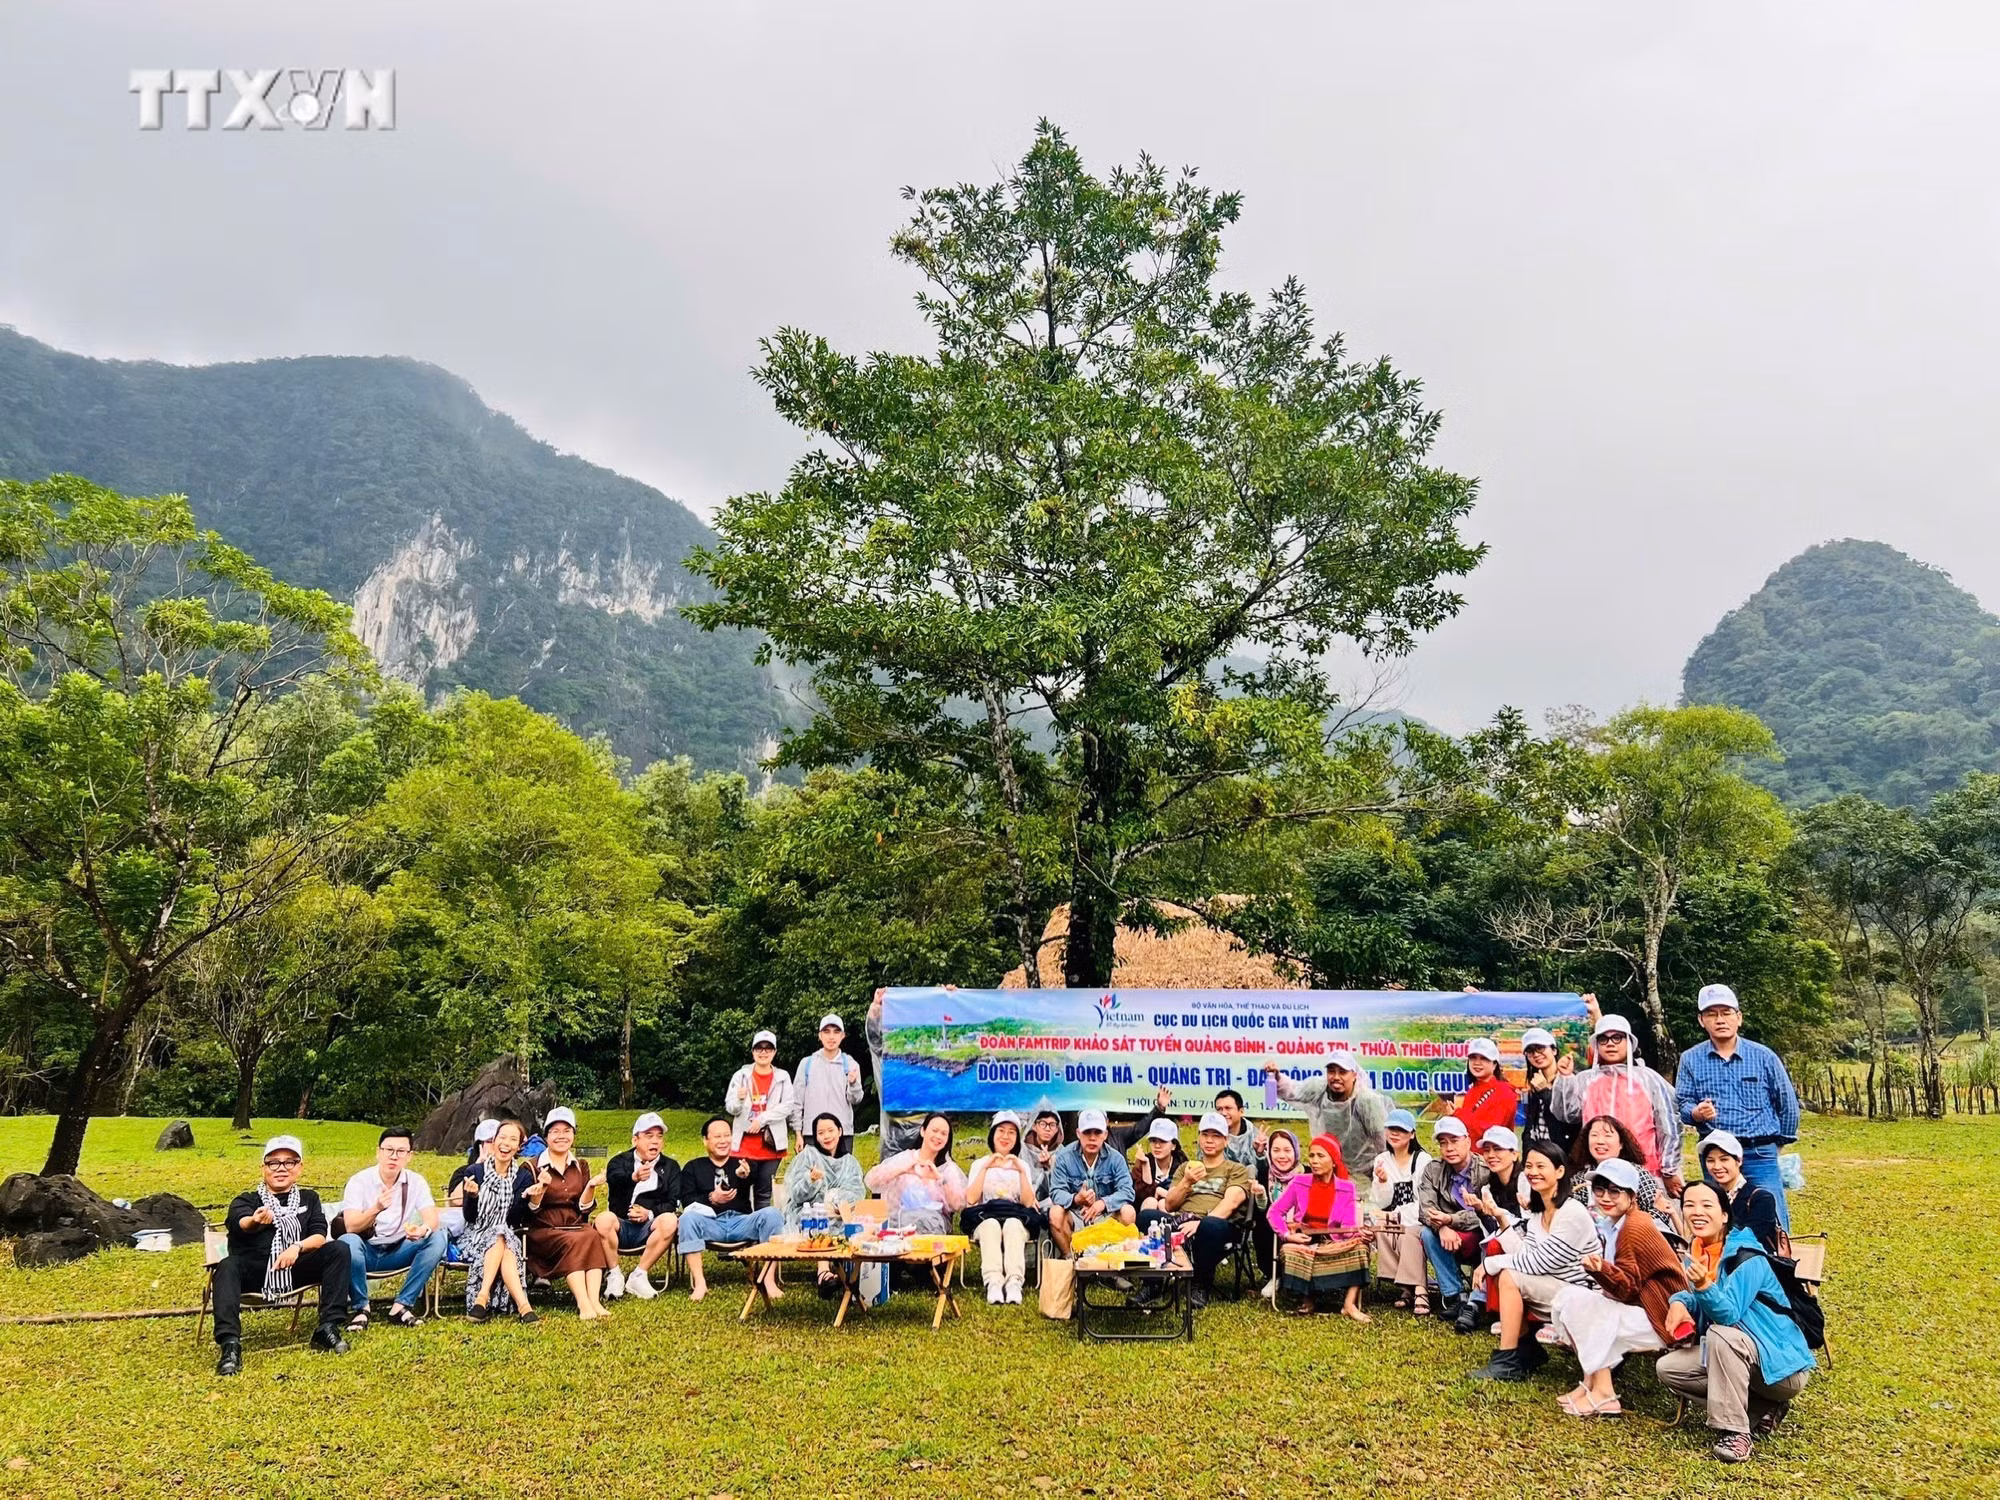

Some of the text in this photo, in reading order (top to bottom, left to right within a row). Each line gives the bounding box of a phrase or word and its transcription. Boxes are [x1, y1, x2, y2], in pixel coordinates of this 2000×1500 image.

[1094, 1005, 1144, 1028] Vietnam
[1251, 1002, 1270, 1010] THAO
[1154, 1014, 1178, 1029] CỤC
[1182, 1015, 1198, 1028] DU
[1202, 1015, 1228, 1030] LỊCH
[1232, 1011, 1265, 1029] QUỐC
[1268, 1016, 1289, 1029] GIA
[1292, 1013, 1318, 1031] VIỆT
[1322, 1016, 1349, 1030] NAM
[979, 1034, 1015, 1049] ĐOÀN
[1018, 1037, 1071, 1050] FAMTRIP
[1074, 1032, 1109, 1051] KHẢO
[1112, 1034, 1136, 1051] SÁT
[1139, 1033, 1181, 1052] TUYẾN
[1184, 1034, 1232, 1053] QUẢNG
[1234, 1036, 1266, 1054] BÌNH
[1276, 1035, 1325, 1055] QUẢNG
[1360, 1040, 1398, 1057] THỪA
[1401, 1040, 1442, 1057] THIÊN
[978, 1058, 1019, 1082] ĐỒNG
[1024, 1061, 1050, 1082] HỚI
[1065, 1062, 1107, 1083] ĐÔNG
[1112, 1062, 1133, 1084] HÀ
[1148, 1062, 1200, 1086] QUẢNG
[1205, 1067, 1231, 1091] TRỊ
[1382, 1067, 1428, 1091] ĐÔNG
[1127, 1096, 1150, 1107] THỜI
[1183, 1098, 1197, 1108] TỪ
